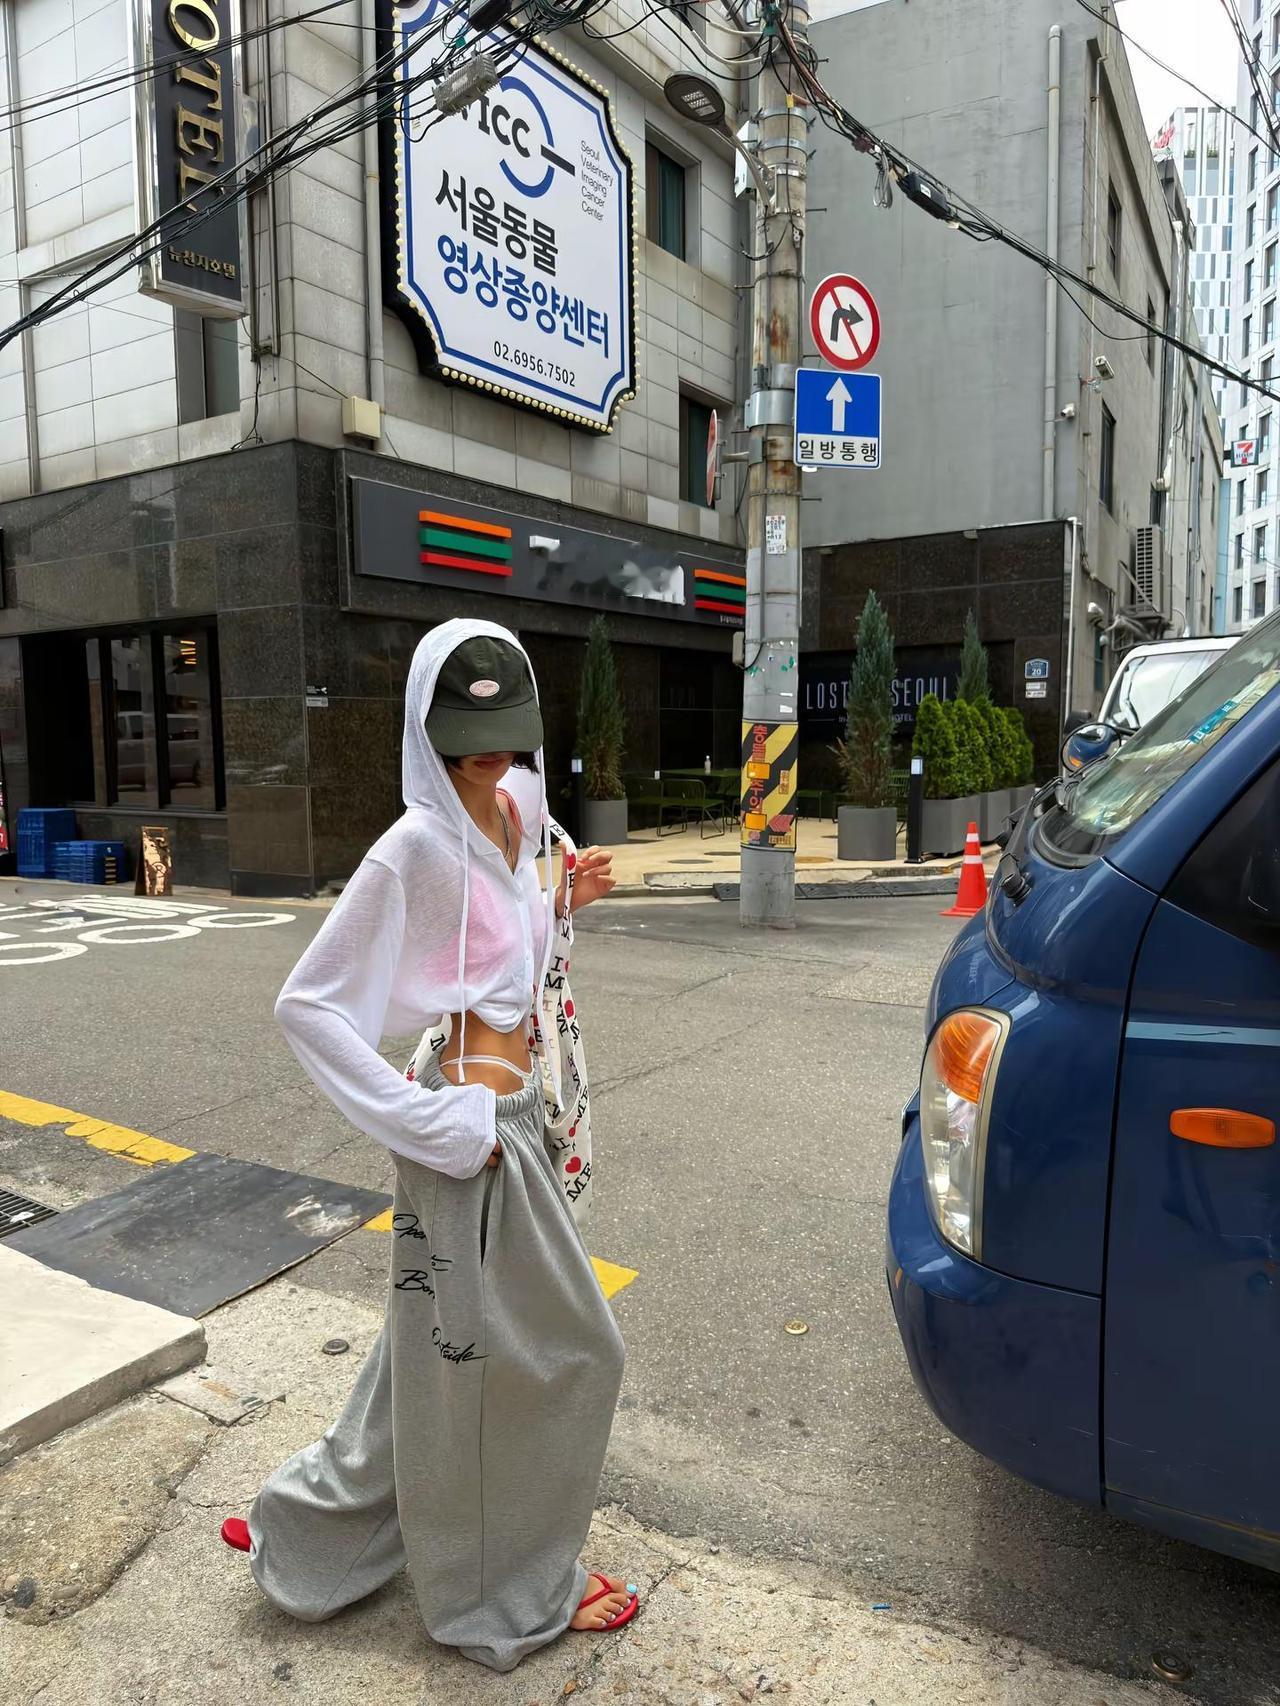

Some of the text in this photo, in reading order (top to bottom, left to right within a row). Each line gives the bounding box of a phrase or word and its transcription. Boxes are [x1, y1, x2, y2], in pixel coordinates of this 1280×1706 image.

[167, 0, 225, 213] OTEL
[581, 140, 600, 162] Seoul
[581, 154, 614, 187] Veterinary
[581, 170, 607, 198] Imaging
[581, 186, 605, 208] Cancer
[581, 200, 605, 221] Center
[435, 169, 559, 277] 서울동물
[437, 234, 609, 359] 영상종양센터
[494, 341, 576, 388] 02.6956.7502
[799, 439, 877, 463] 일방통행
[806, 681, 849, 710] LOST
